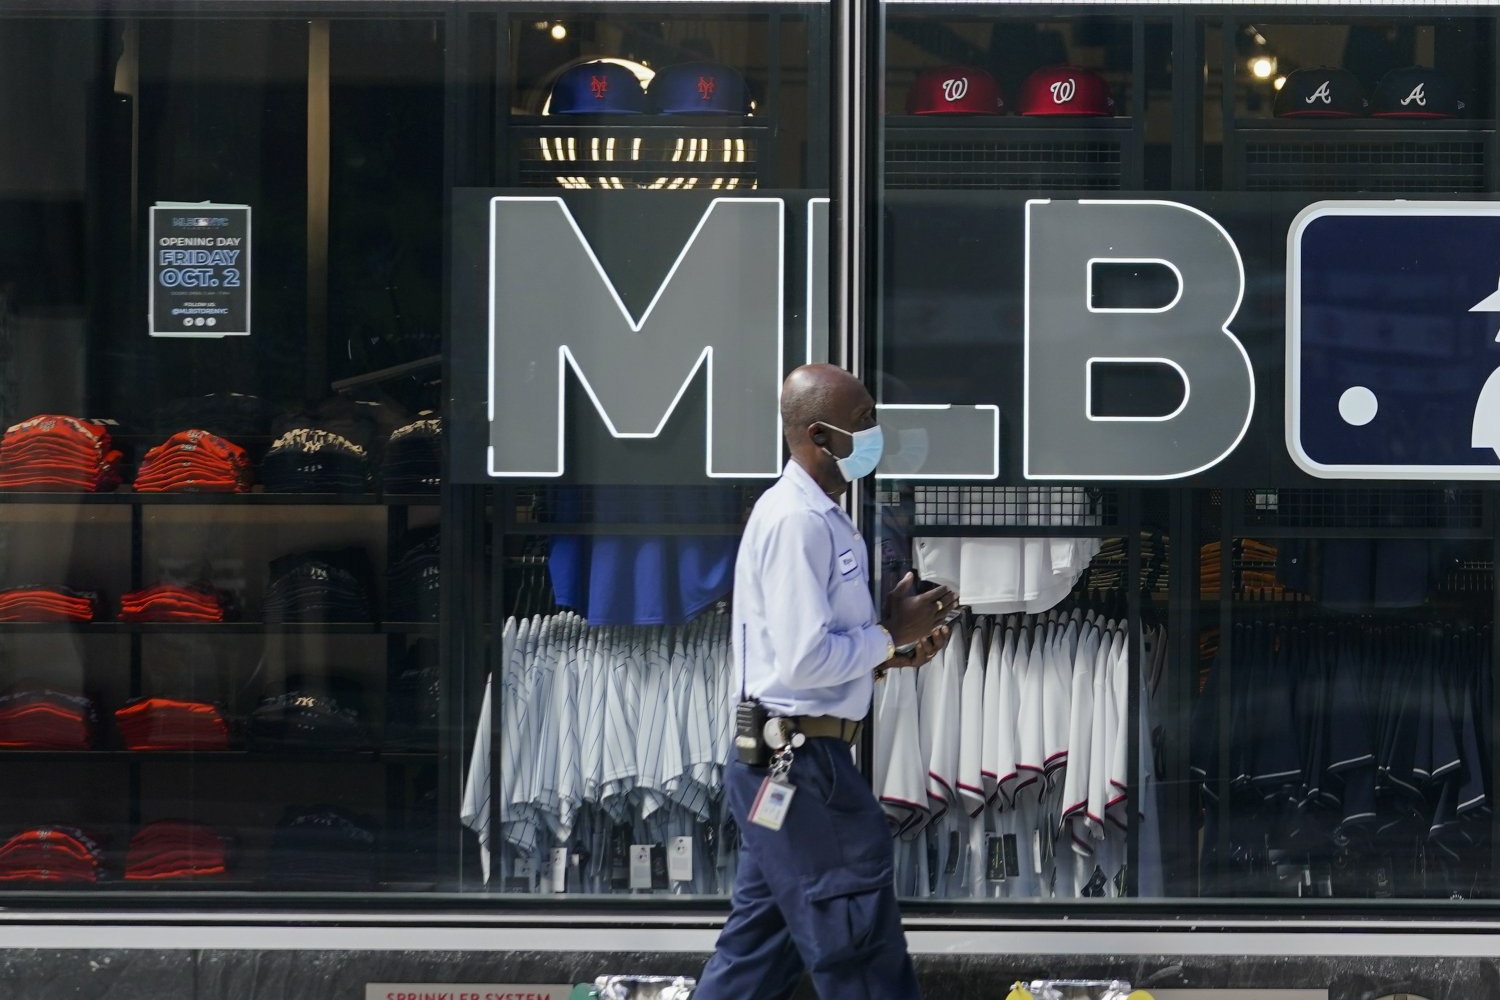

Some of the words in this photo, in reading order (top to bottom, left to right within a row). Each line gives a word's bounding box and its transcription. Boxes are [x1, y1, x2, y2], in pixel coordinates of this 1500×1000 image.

[942, 77, 968, 101] W
[1050, 78, 1075, 104] W
[1305, 80, 1331, 104] A
[1400, 82, 1426, 106] A
[160, 237, 214, 246] OPENING
[216, 237, 241, 246] DAY
[160, 249, 240, 266] FRIDAY
[160, 267, 219, 287] OCT.
[222, 267, 241, 287] 2
